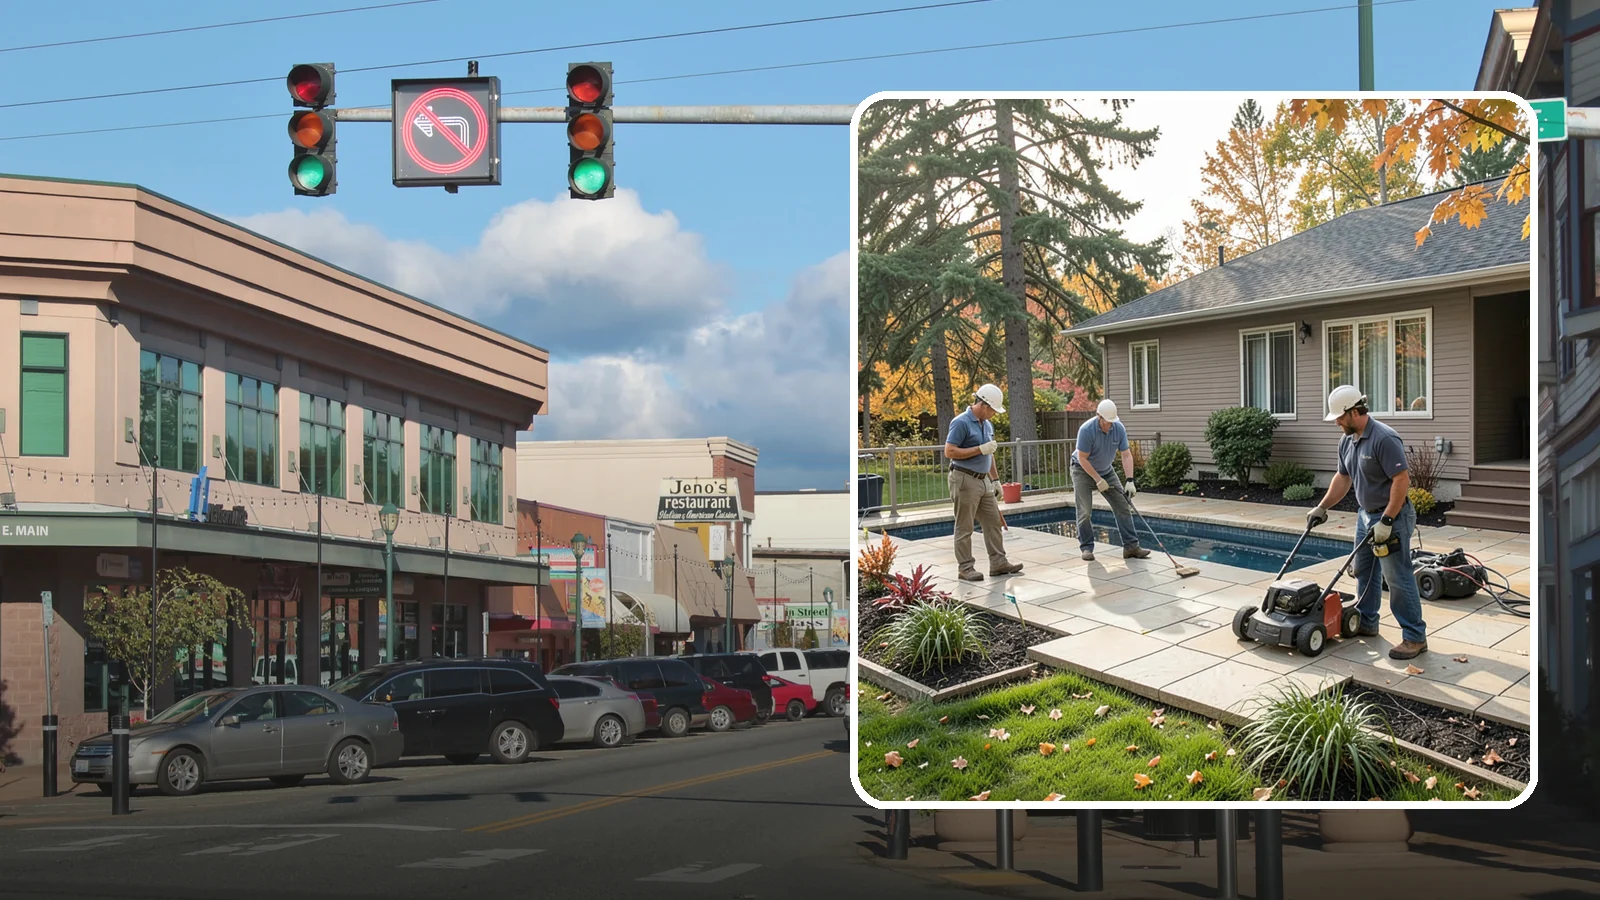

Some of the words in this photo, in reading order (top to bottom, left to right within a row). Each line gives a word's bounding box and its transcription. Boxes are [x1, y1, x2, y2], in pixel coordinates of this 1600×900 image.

[669, 481, 728, 494] Jeno's
[664, 495, 731, 509] restaurant
[658, 509, 682, 519] Italian
[686, 509, 714, 519] American
[714, 509, 737, 519] Cuisine
[2, 525, 13, 536] E.
[15, 525, 49, 536] MAIN
[797, 607, 828, 617] Street
